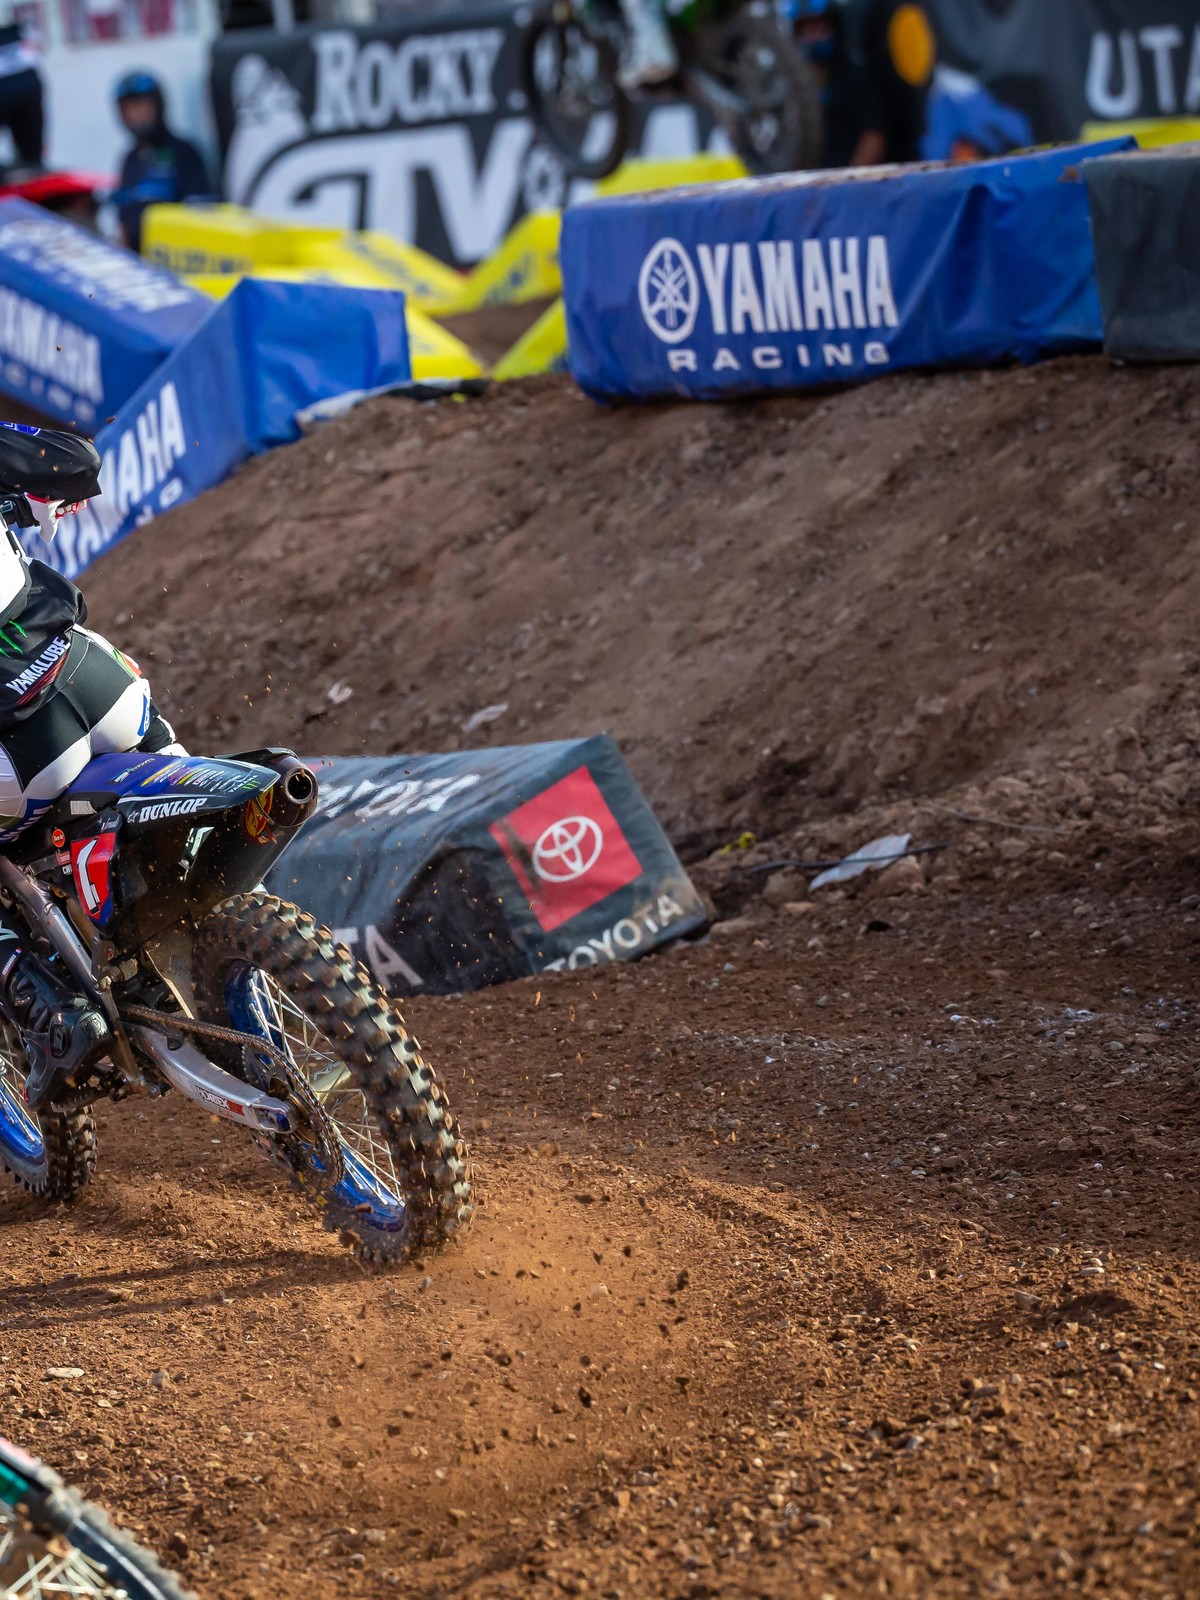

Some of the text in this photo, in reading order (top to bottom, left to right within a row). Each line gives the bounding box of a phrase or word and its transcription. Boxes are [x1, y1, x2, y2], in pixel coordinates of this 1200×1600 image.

[311, 29, 503, 131] ROCKY
[696, 235, 900, 334] YAMAHA
[667, 341, 890, 372] RACING
[5, 635, 71, 695] YAMALUBE
[138, 797, 209, 824] DUNLOP
